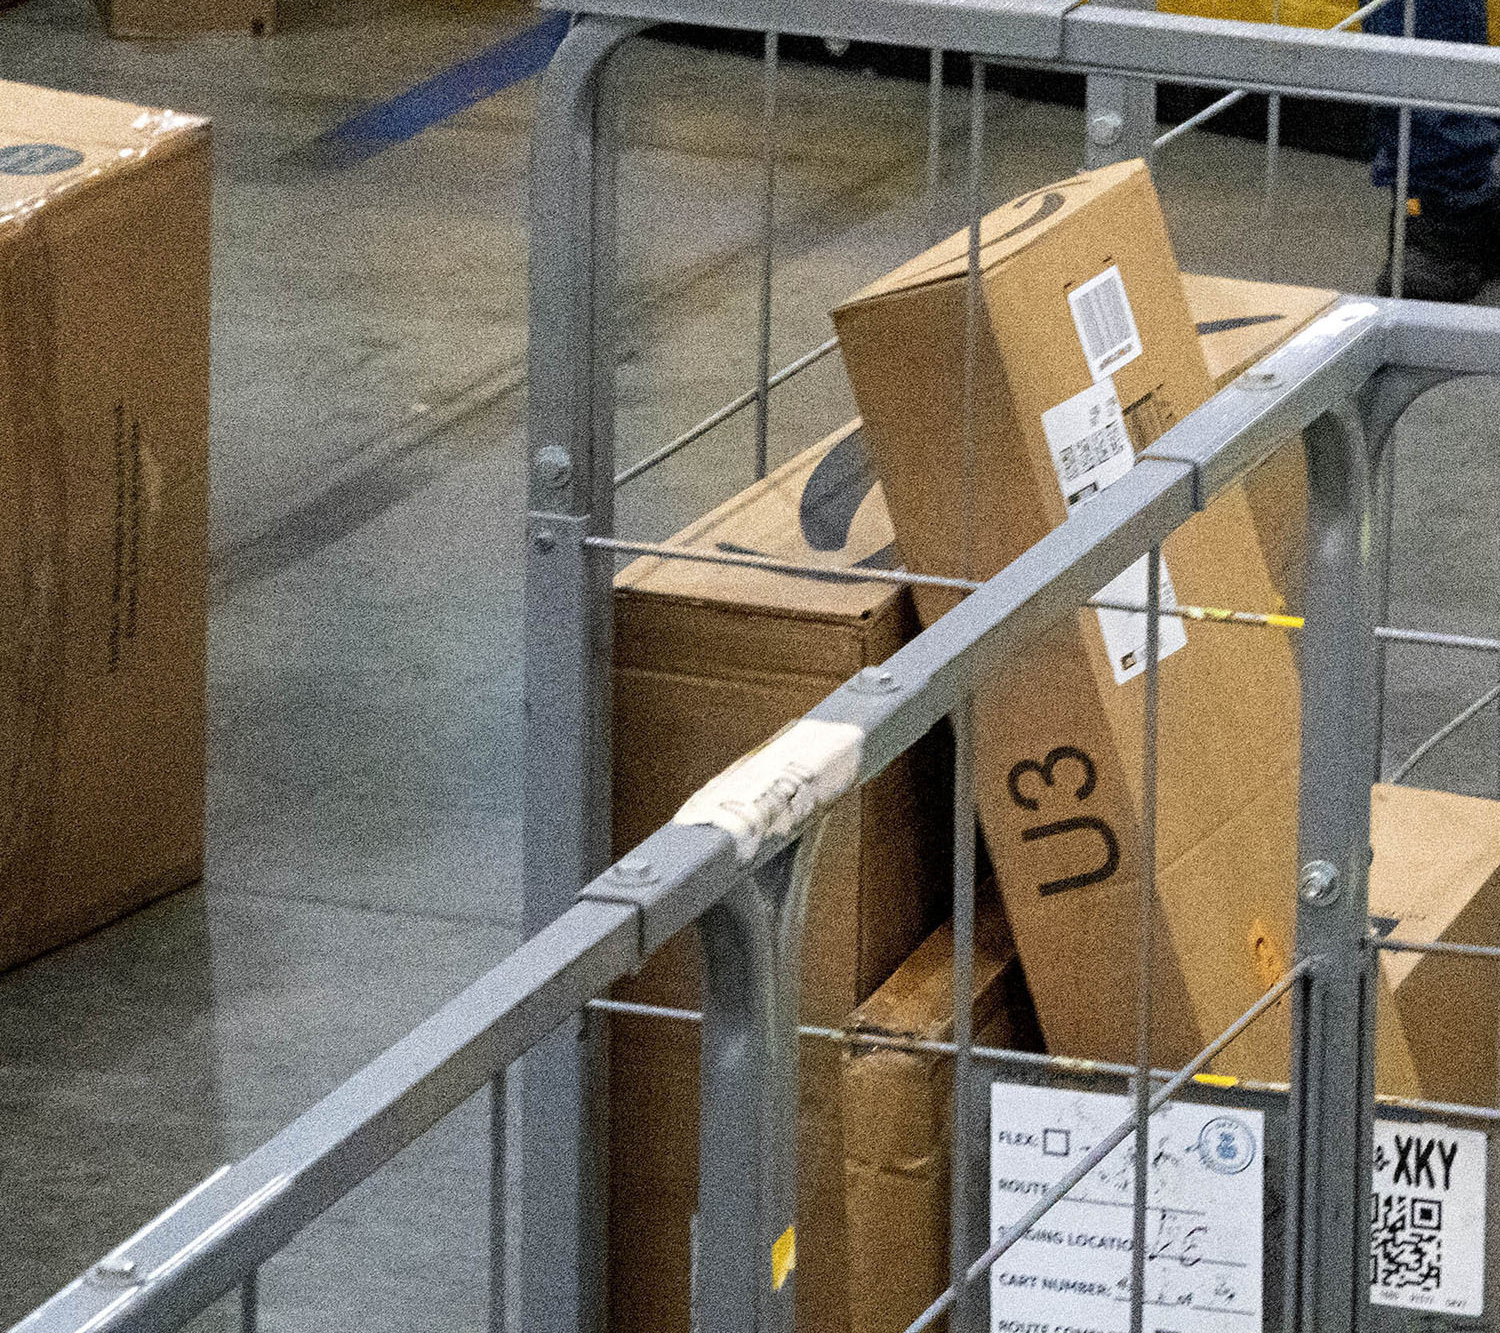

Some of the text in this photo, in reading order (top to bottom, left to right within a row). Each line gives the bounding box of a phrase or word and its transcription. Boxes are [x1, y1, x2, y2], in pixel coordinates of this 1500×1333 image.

[1007, 745, 1120, 897] U3
[998, 1129, 1037, 1148] FLEX:
[1392, 1133, 1459, 1191] XKY
[998, 1271, 1037, 1290] CART
[1040, 1276, 1113, 1297] NUMBER:
